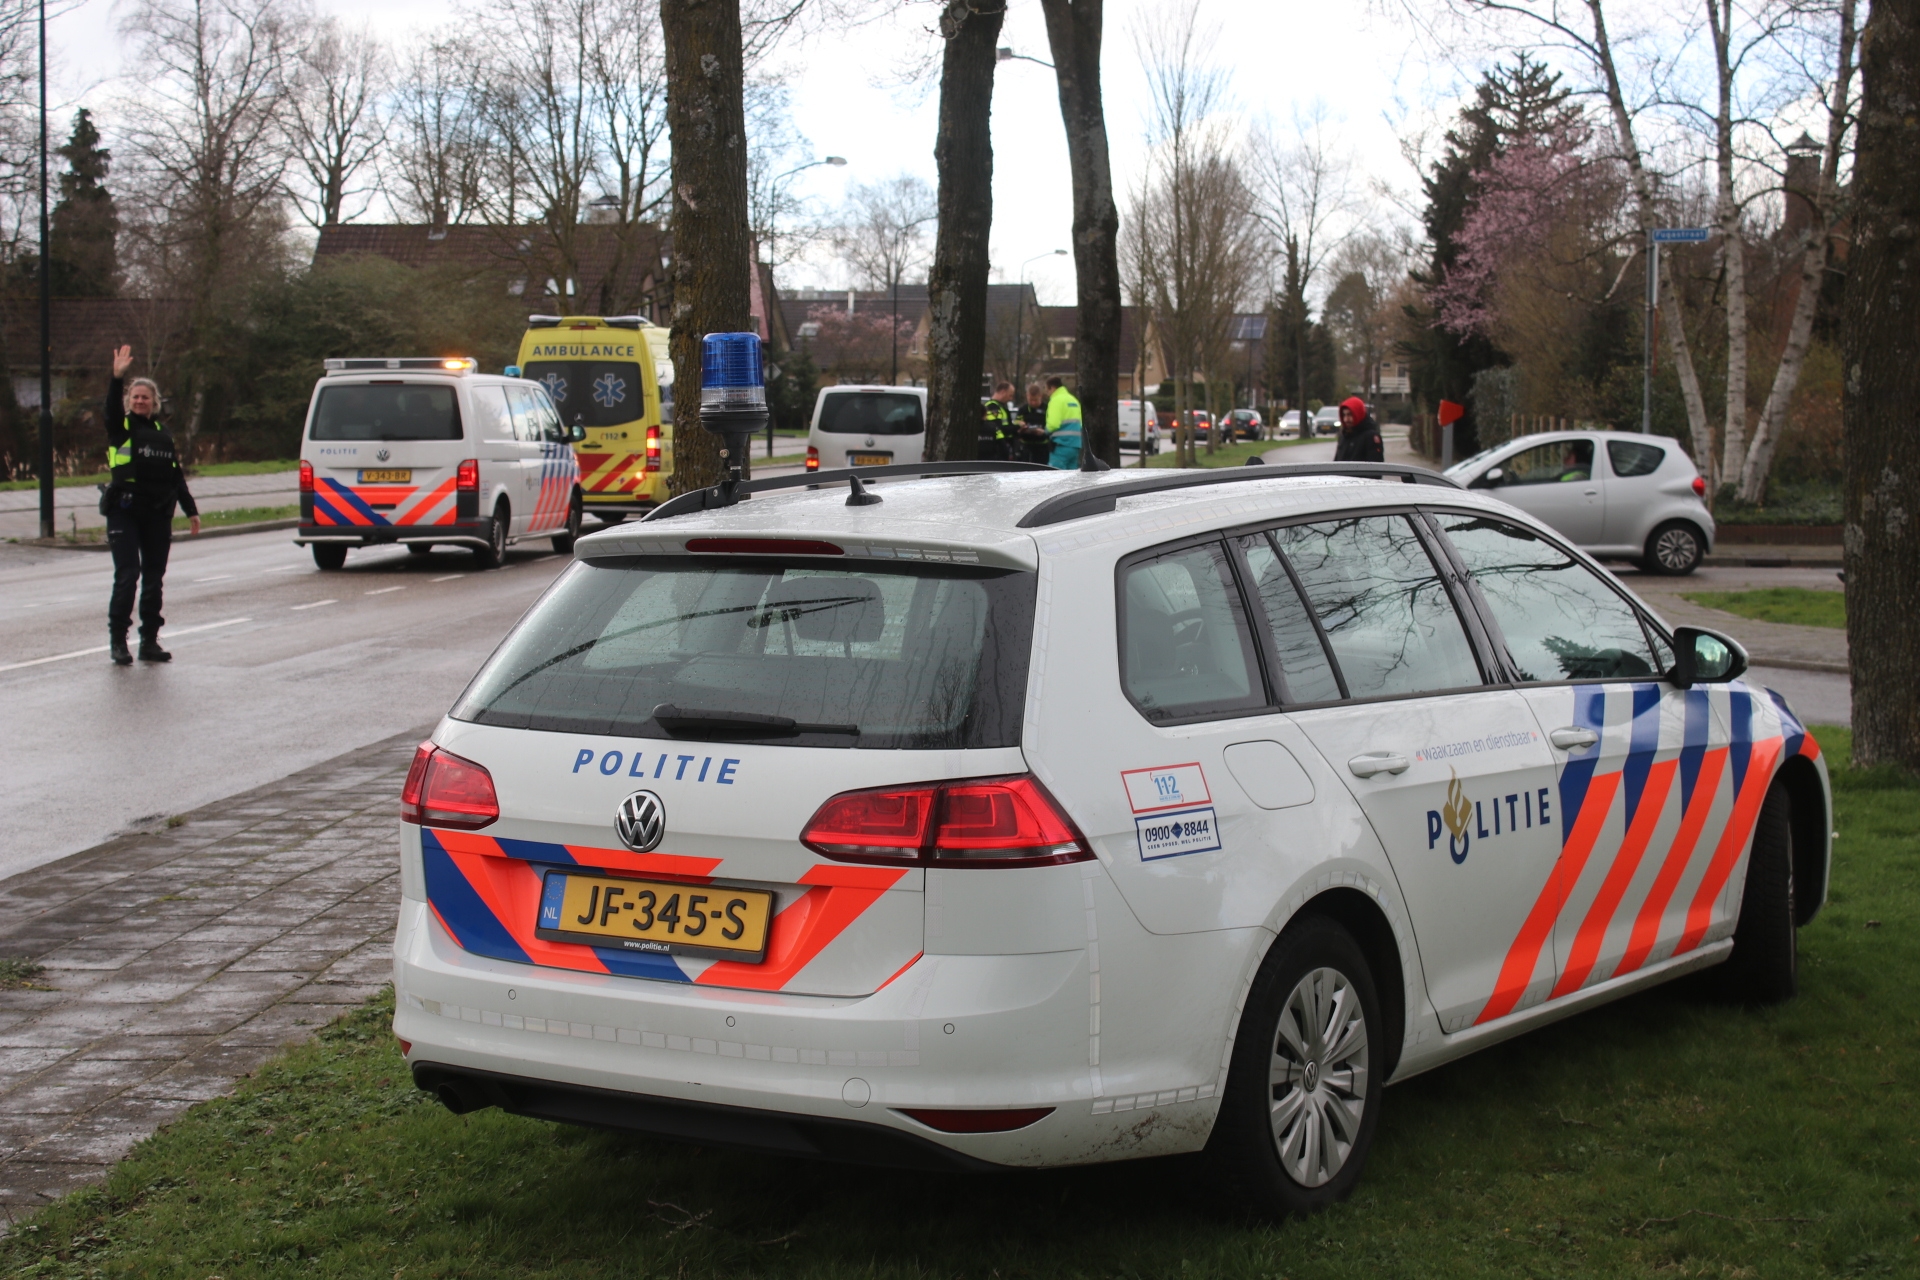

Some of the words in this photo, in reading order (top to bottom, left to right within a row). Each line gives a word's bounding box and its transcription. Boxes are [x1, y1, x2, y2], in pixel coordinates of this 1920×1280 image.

[532, 345, 635, 357] AMBULANCE
[366, 471, 407, 480] V-343-BR
[1474, 739, 1487, 752] en
[572, 749, 741, 785] POLITIE
[1145, 825, 1170, 843] 0900
[1184, 819, 1209, 836] 8844
[1427, 787, 1551, 865] POLITIE
[543, 906, 558, 920] NL
[577, 885, 747, 941] JF-345-S
[623, 940, 670, 952] www.politie.nl
